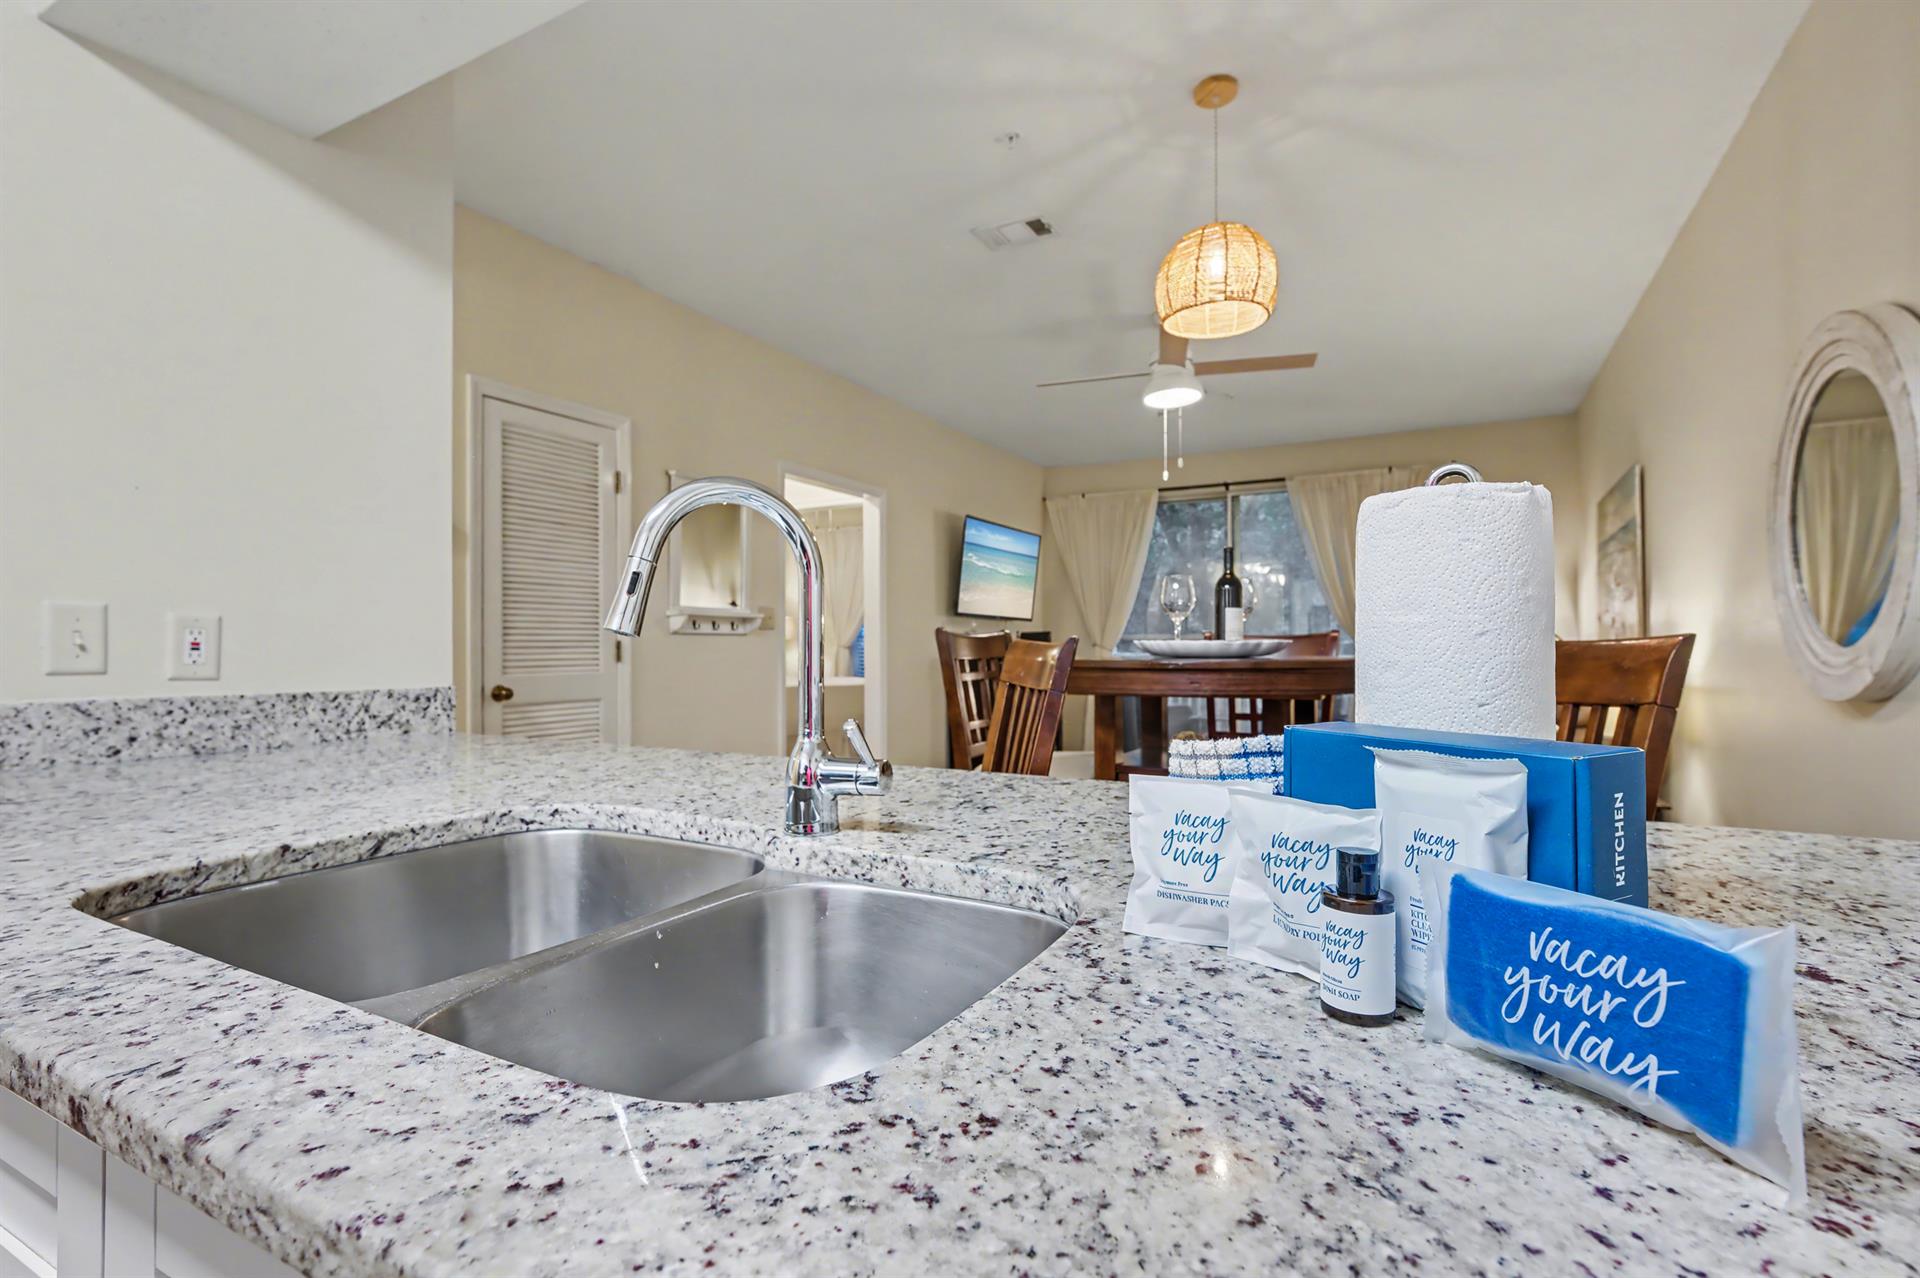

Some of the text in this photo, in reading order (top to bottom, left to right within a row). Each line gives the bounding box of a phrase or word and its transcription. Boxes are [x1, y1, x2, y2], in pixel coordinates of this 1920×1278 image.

[1160, 828, 1209, 856] your
[1614, 792, 1626, 887] KITCHEN
[1260, 851, 1313, 879] your
[1156, 889, 1209, 907] DISHWASHER
[1321, 932, 1351, 952] your
[1529, 926, 1687, 1029] vacay
[1337, 989, 1361, 1002] SOAP
[1500, 965, 1627, 1025] your
